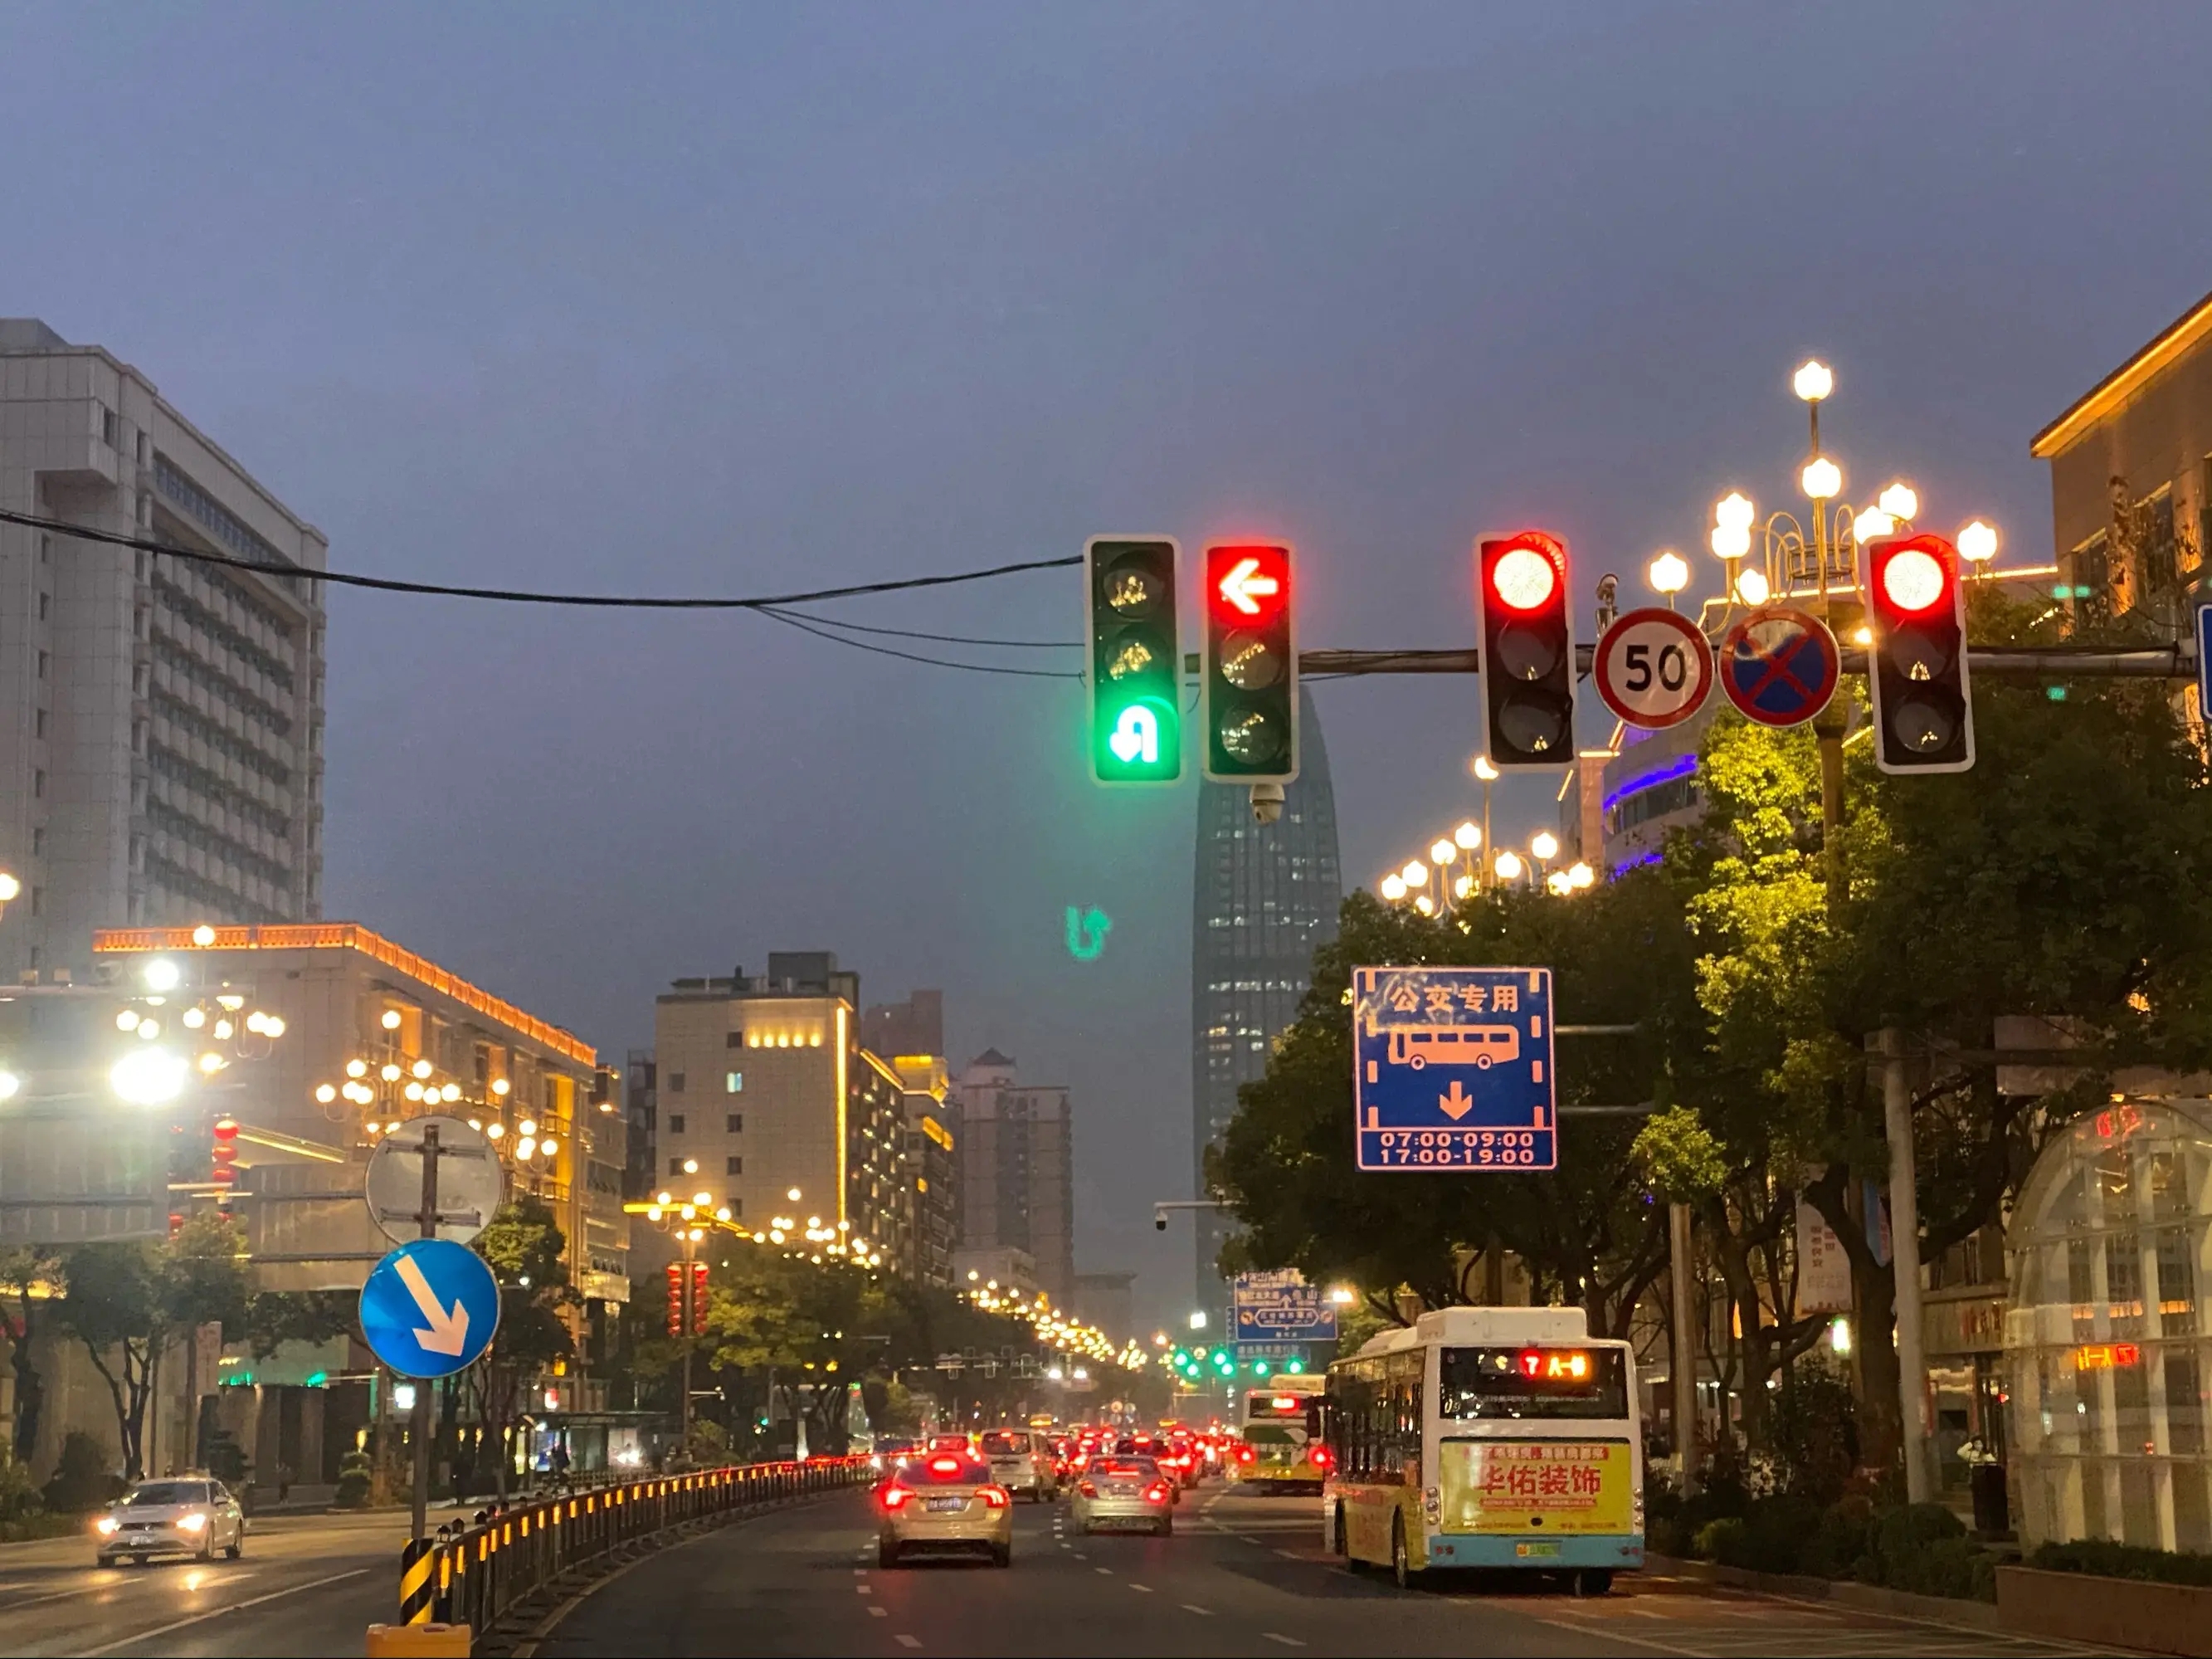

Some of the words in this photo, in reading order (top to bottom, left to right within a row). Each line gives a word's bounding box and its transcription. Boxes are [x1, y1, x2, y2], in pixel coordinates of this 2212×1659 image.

[1625, 644, 1686, 691] 50
[1390, 984, 1518, 1013] 公交专用
[1380, 1132, 1534, 1148] 07:00-09:00
[1381, 1149, 1534, 1164] 17:00-19:00
[1525, 1356, 1539, 1375] 7
